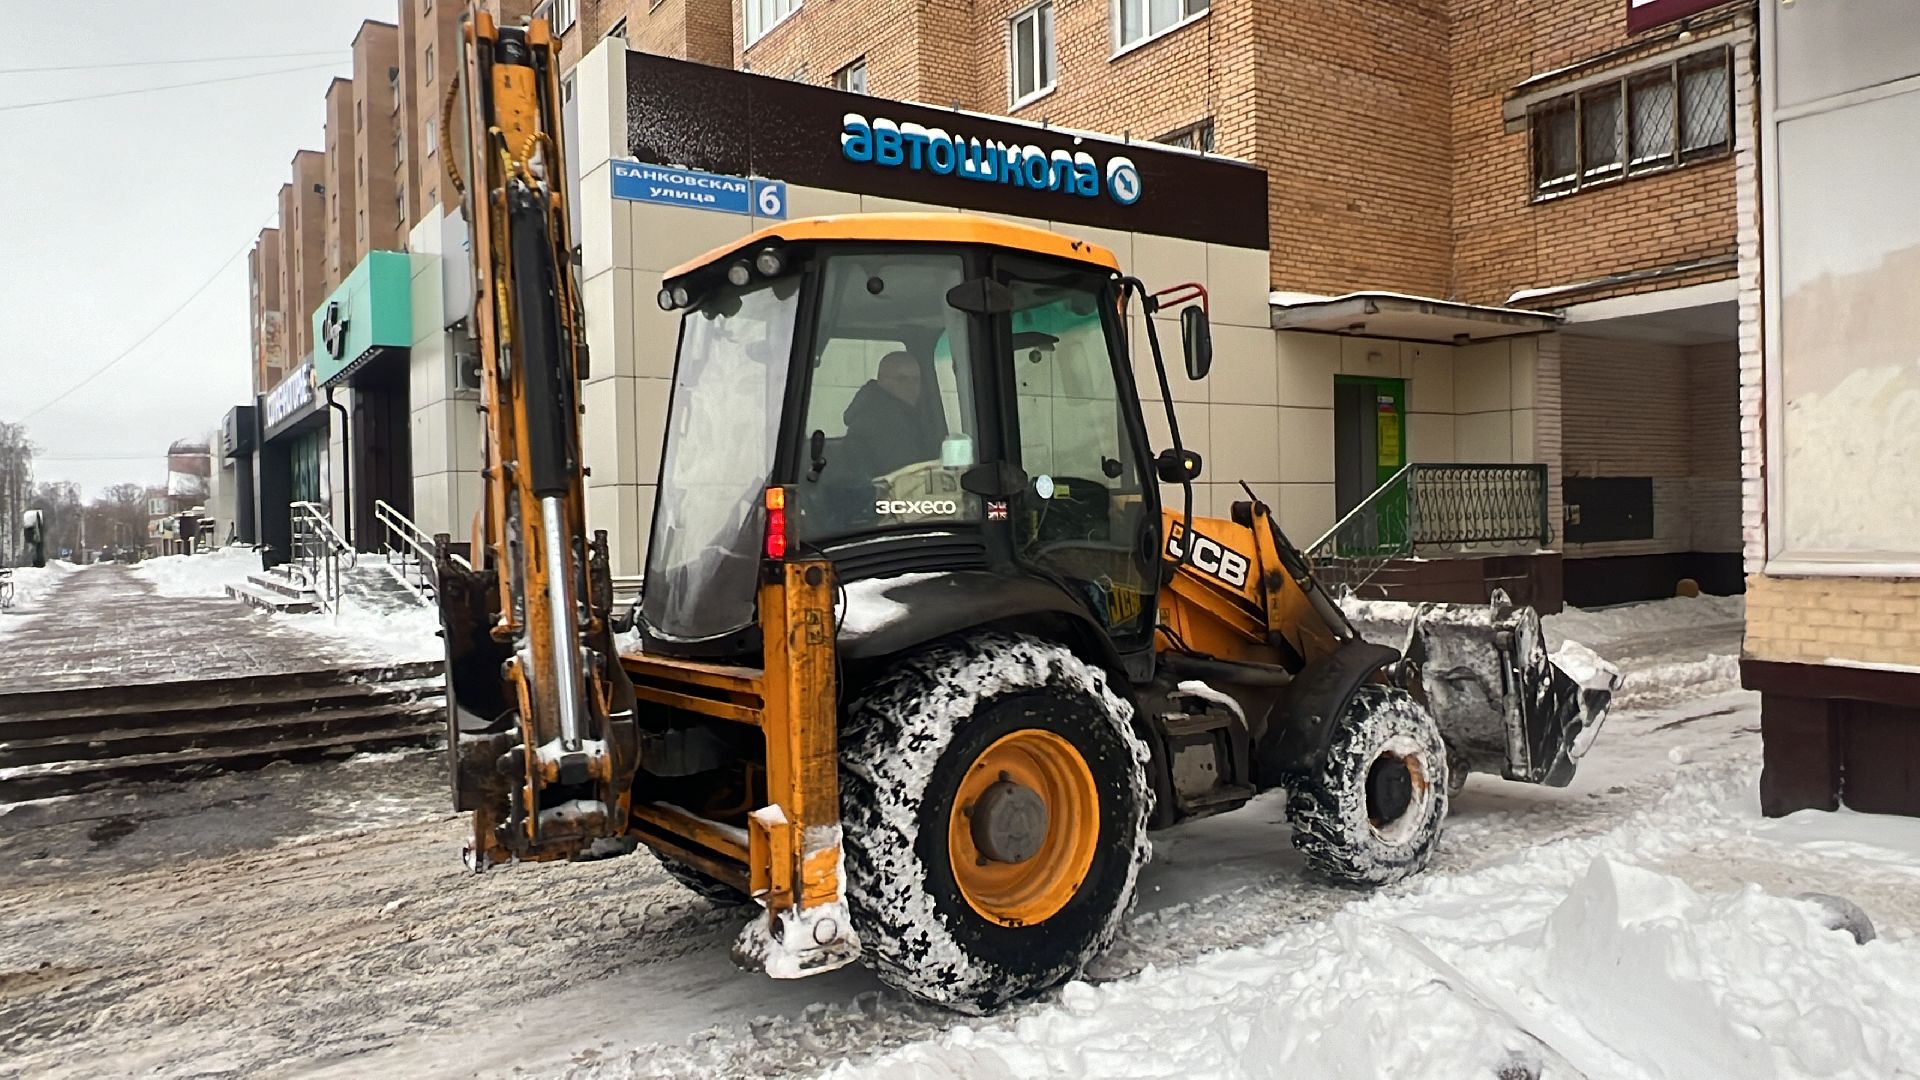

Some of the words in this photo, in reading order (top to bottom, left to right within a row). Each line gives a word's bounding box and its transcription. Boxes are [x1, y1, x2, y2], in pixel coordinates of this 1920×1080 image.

[841, 114, 1099, 197] автошкола
[615, 166, 747, 194] БАНКОВСКАЯ
[650, 186, 716, 203] улица
[759, 185, 782, 216] 6
[1169, 531, 1248, 587] JCB
